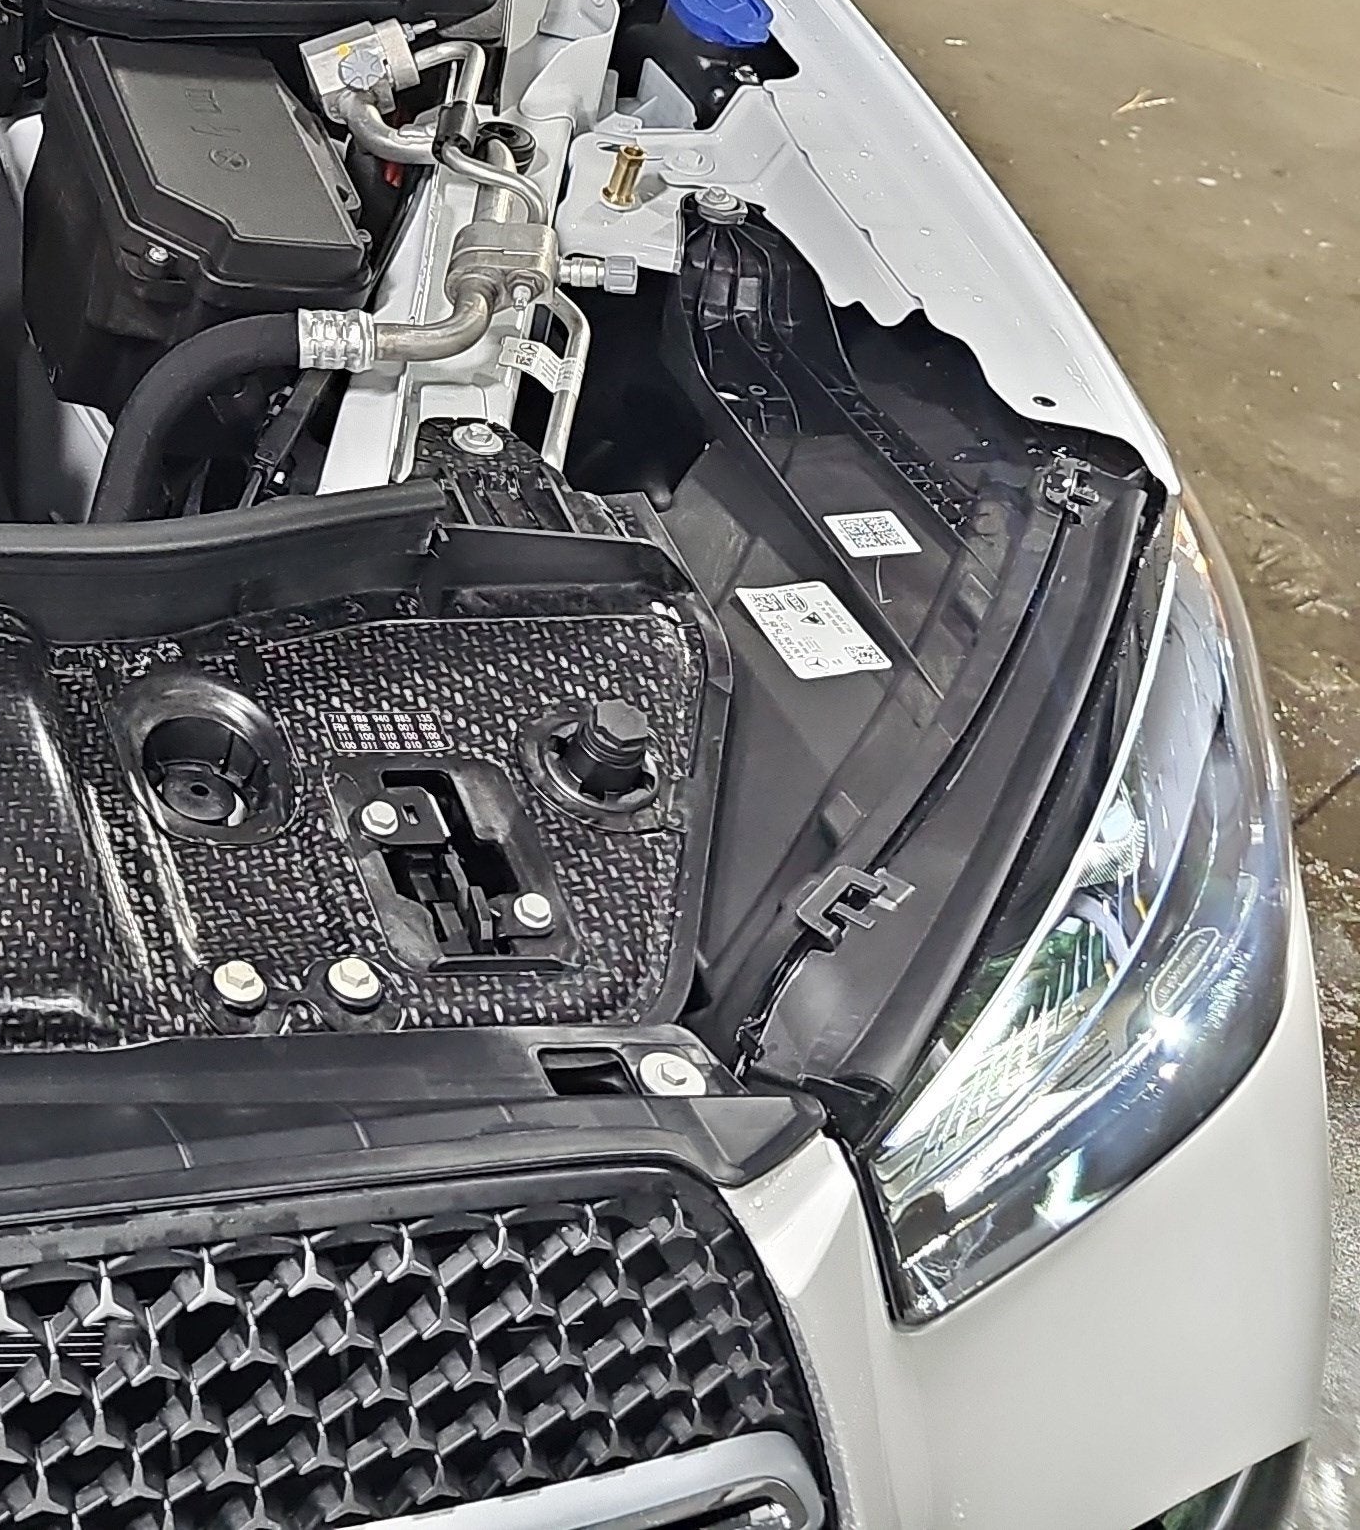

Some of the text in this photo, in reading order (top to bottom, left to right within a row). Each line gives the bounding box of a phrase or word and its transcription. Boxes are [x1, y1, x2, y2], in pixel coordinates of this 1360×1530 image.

[371, 713, 390, 723] 940
[376, 723, 394, 732] 110
[397, 723, 415, 732] 001
[419, 722, 437, 732] 000
[337, 731, 440, 741] 111 100 010 100 100
[340, 741, 357, 750] 100
[360, 741, 378, 750] 011
[383, 741, 401, 750] 100
[404, 740, 422, 750] 010
